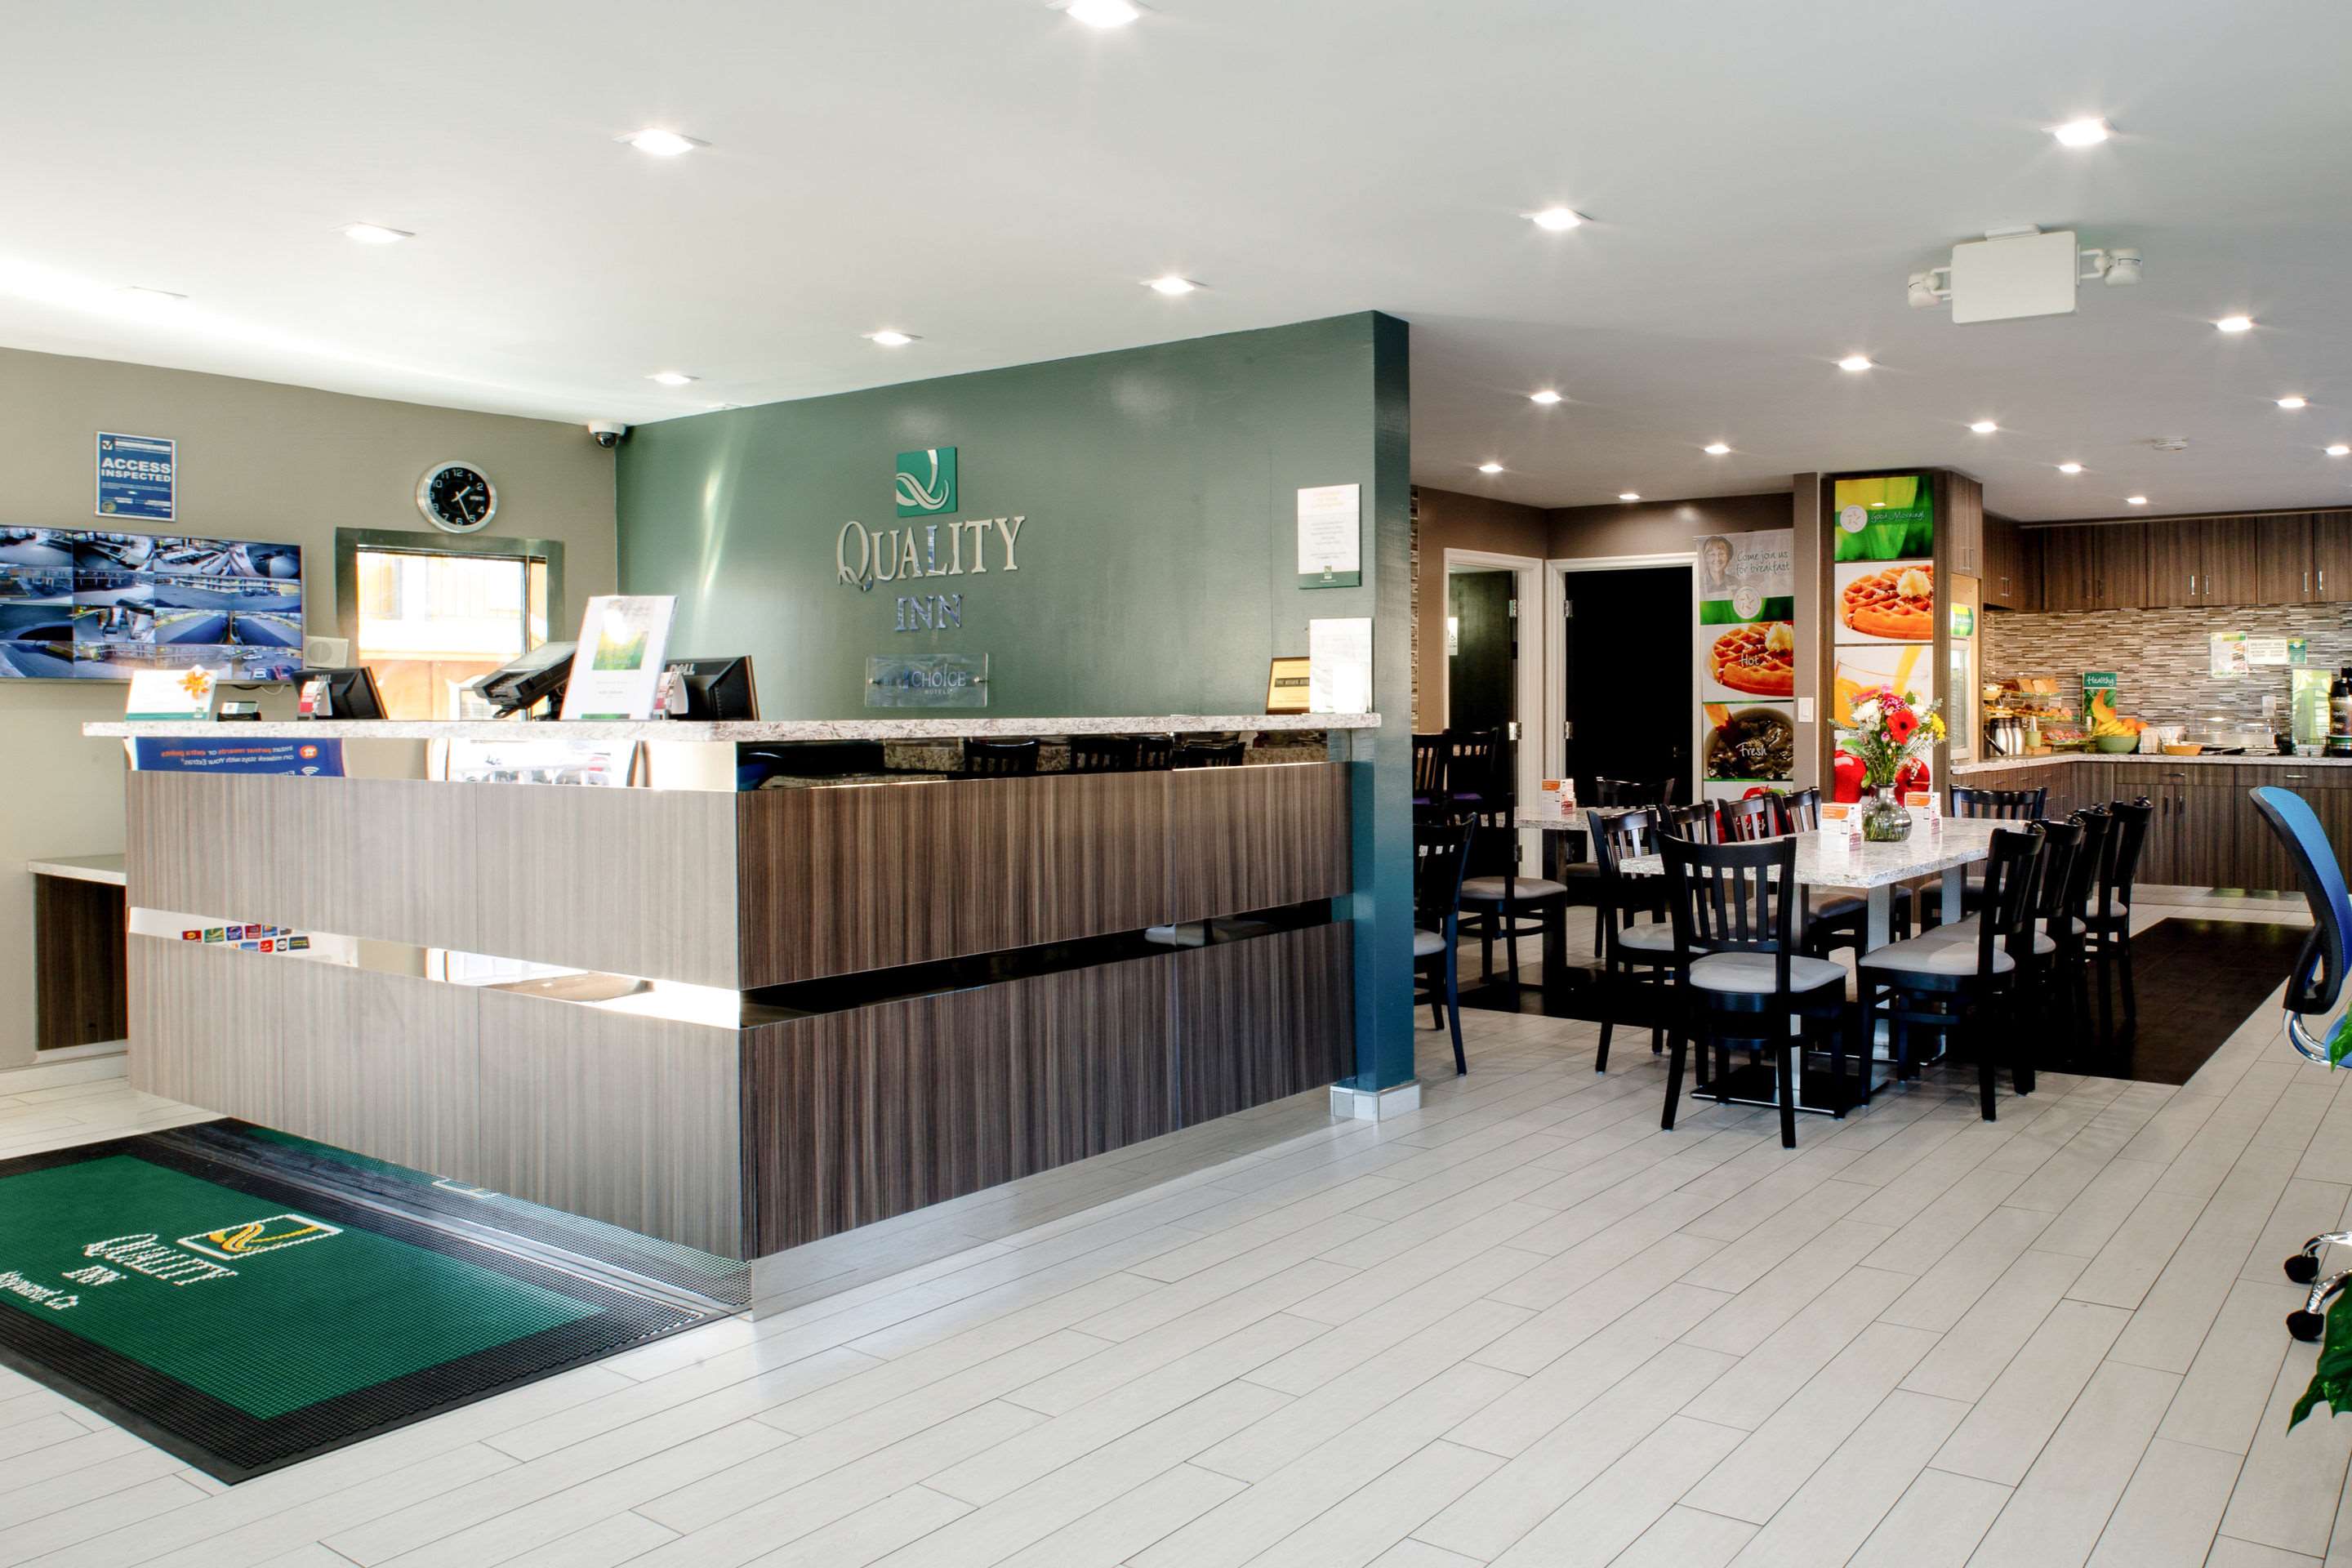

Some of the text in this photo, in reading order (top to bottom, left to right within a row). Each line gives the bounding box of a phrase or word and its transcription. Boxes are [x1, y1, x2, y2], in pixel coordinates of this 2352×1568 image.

[102, 457, 171, 474] ACCESS
[101, 470, 171, 483] INSPECTED
[452, 469, 464, 478] 12
[476, 483, 483, 491] 2
[470, 514, 476, 523] 5
[836, 515, 1027, 591] QUALITY
[1737, 550, 1789, 564] Come join us
[1736, 562, 1790, 577] for breakfast
[894, 594, 964, 631] INN
[1739, 653, 1760, 667] Hot
[911, 664, 966, 688] CHOICE
[2087, 676, 2114, 687] Healthy
[1735, 742, 1768, 757] Fresh
[82, 1233, 238, 1285] QUALITY
[61, 1265, 128, 1286] INN
